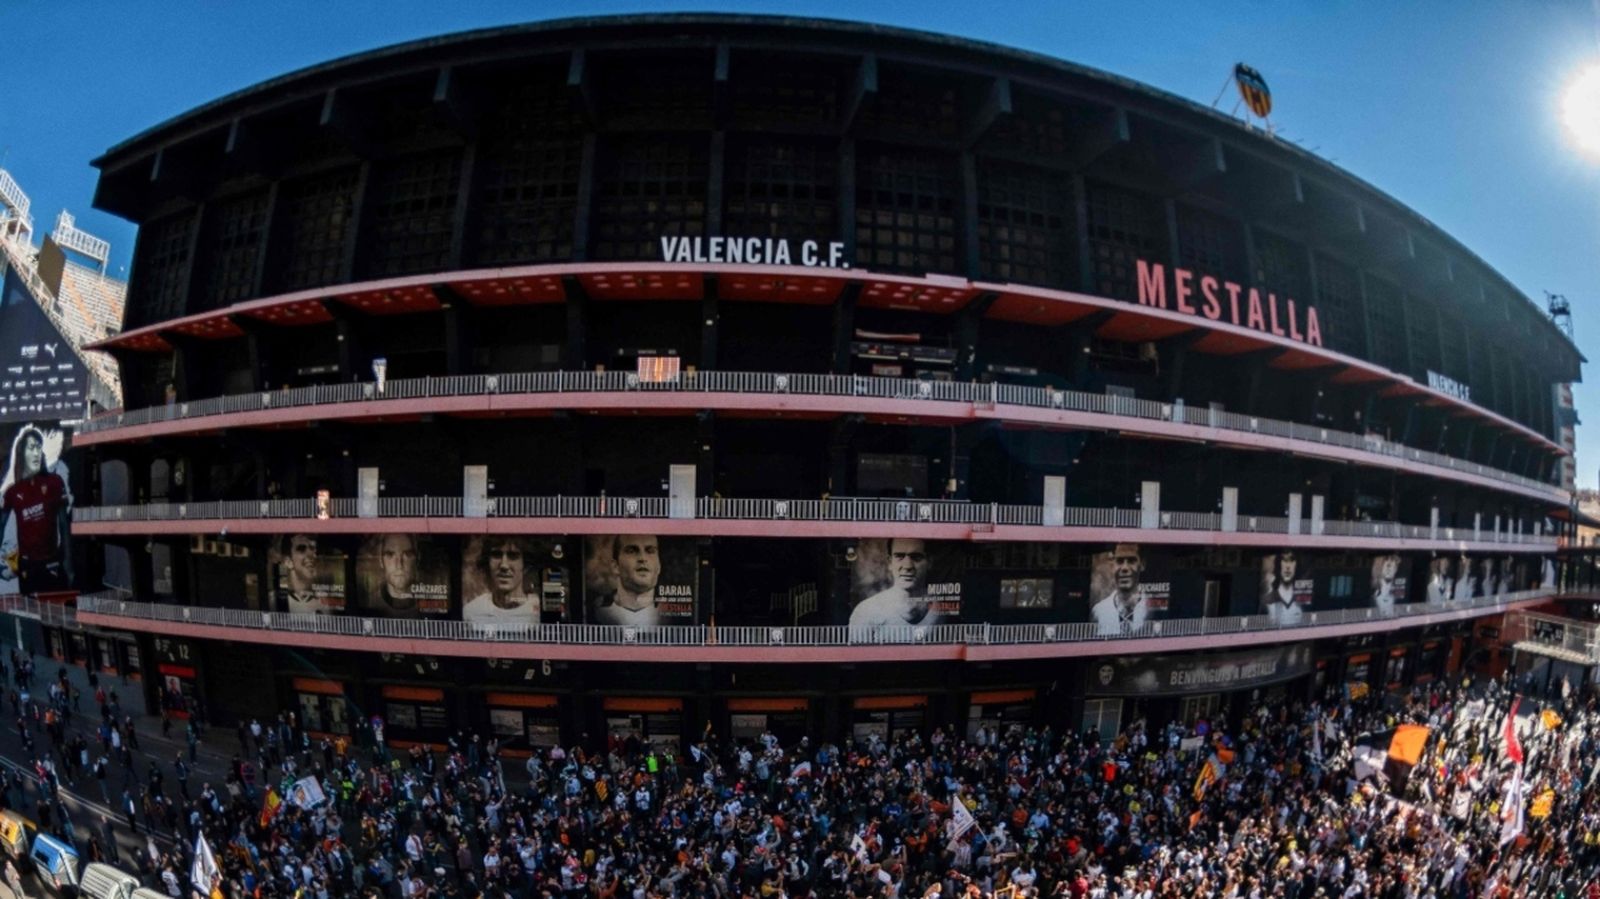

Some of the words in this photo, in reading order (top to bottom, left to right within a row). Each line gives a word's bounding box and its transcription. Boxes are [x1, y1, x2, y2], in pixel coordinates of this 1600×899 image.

[661, 236, 790, 264] VALENCIA
[800, 240, 848, 268] C.F.
[1137, 259, 1322, 347] MESTALLA
[659, 585, 692, 597] BARAJA
[927, 583, 961, 595] MUNDO
